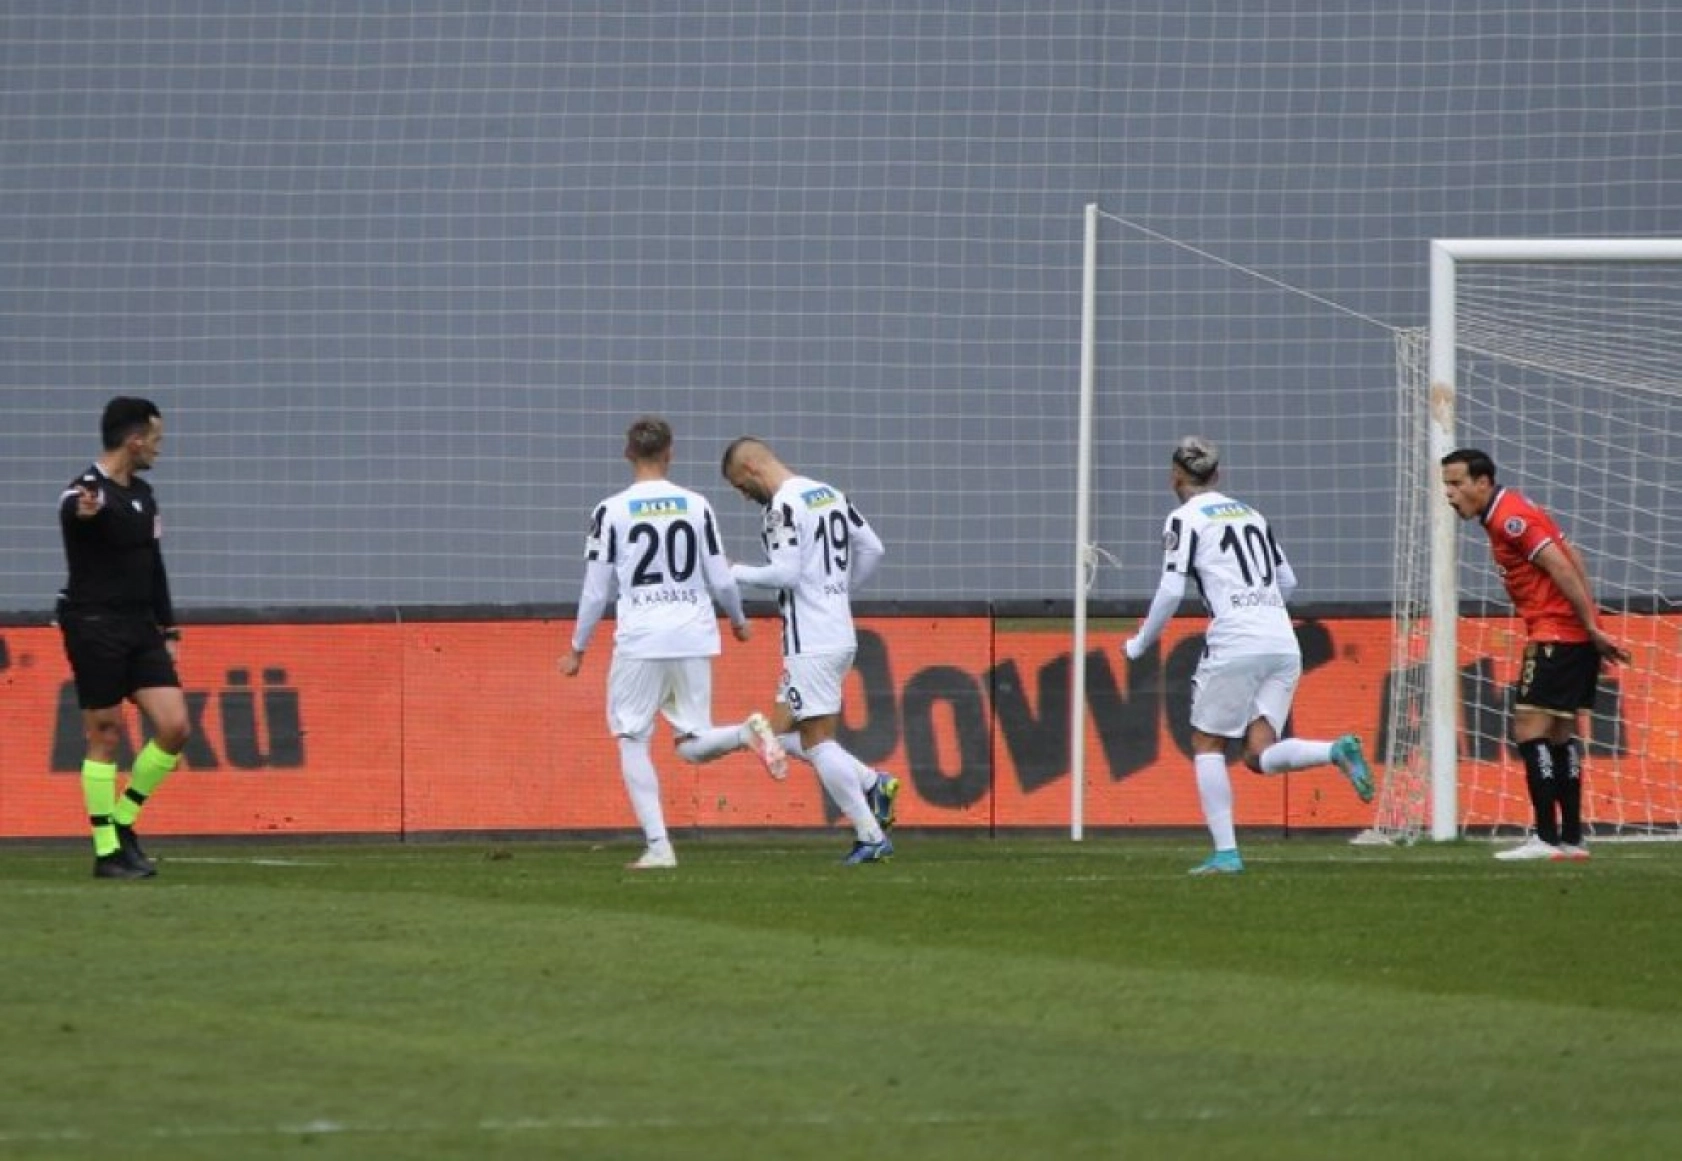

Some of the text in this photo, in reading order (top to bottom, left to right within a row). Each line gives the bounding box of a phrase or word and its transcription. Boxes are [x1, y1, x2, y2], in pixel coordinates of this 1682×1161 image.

[628, 520, 698, 587] 20
[814, 509, 849, 576] 19
[1219, 523, 1273, 588] 10
